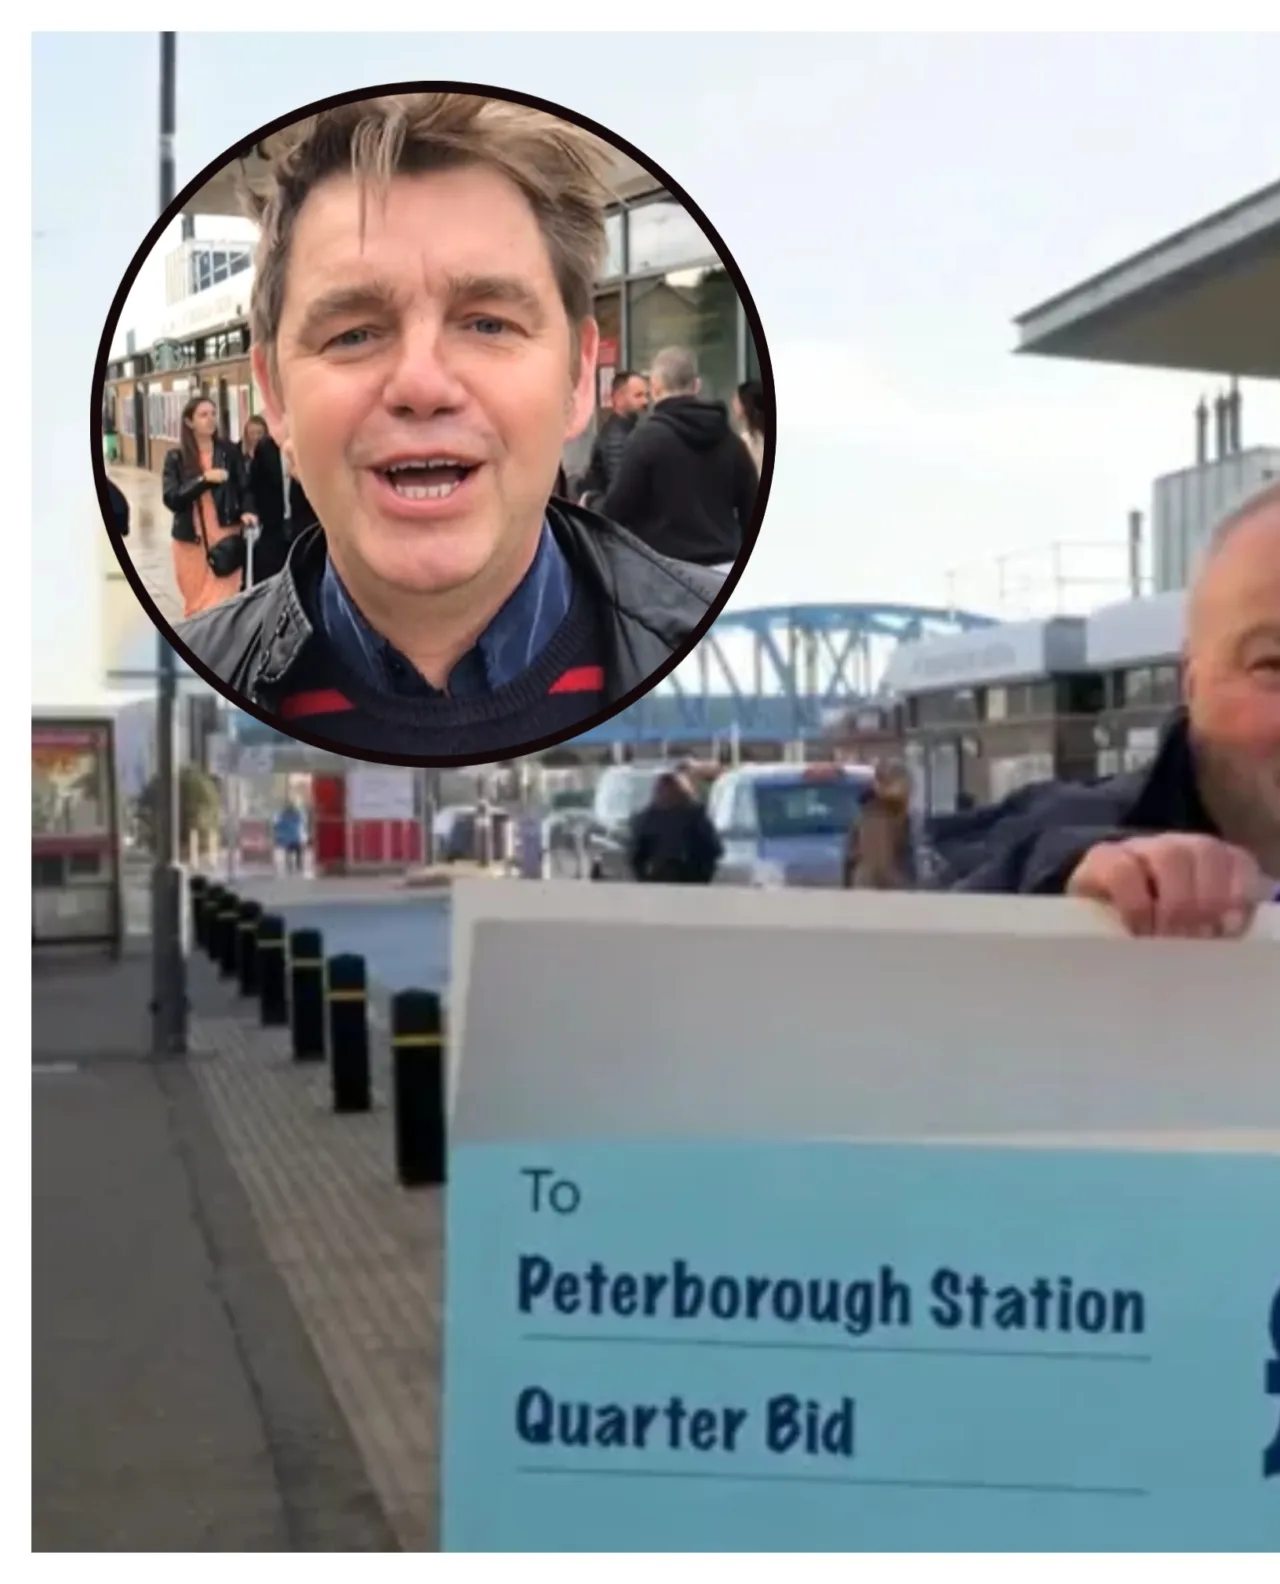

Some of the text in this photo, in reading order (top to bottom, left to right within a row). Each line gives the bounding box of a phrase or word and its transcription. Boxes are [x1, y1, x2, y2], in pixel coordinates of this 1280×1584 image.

[521, 1168, 580, 1215] To
[517, 1255, 1145, 1336] Peterborough Station
[515, 1386, 855, 1458] Quarter Bid
